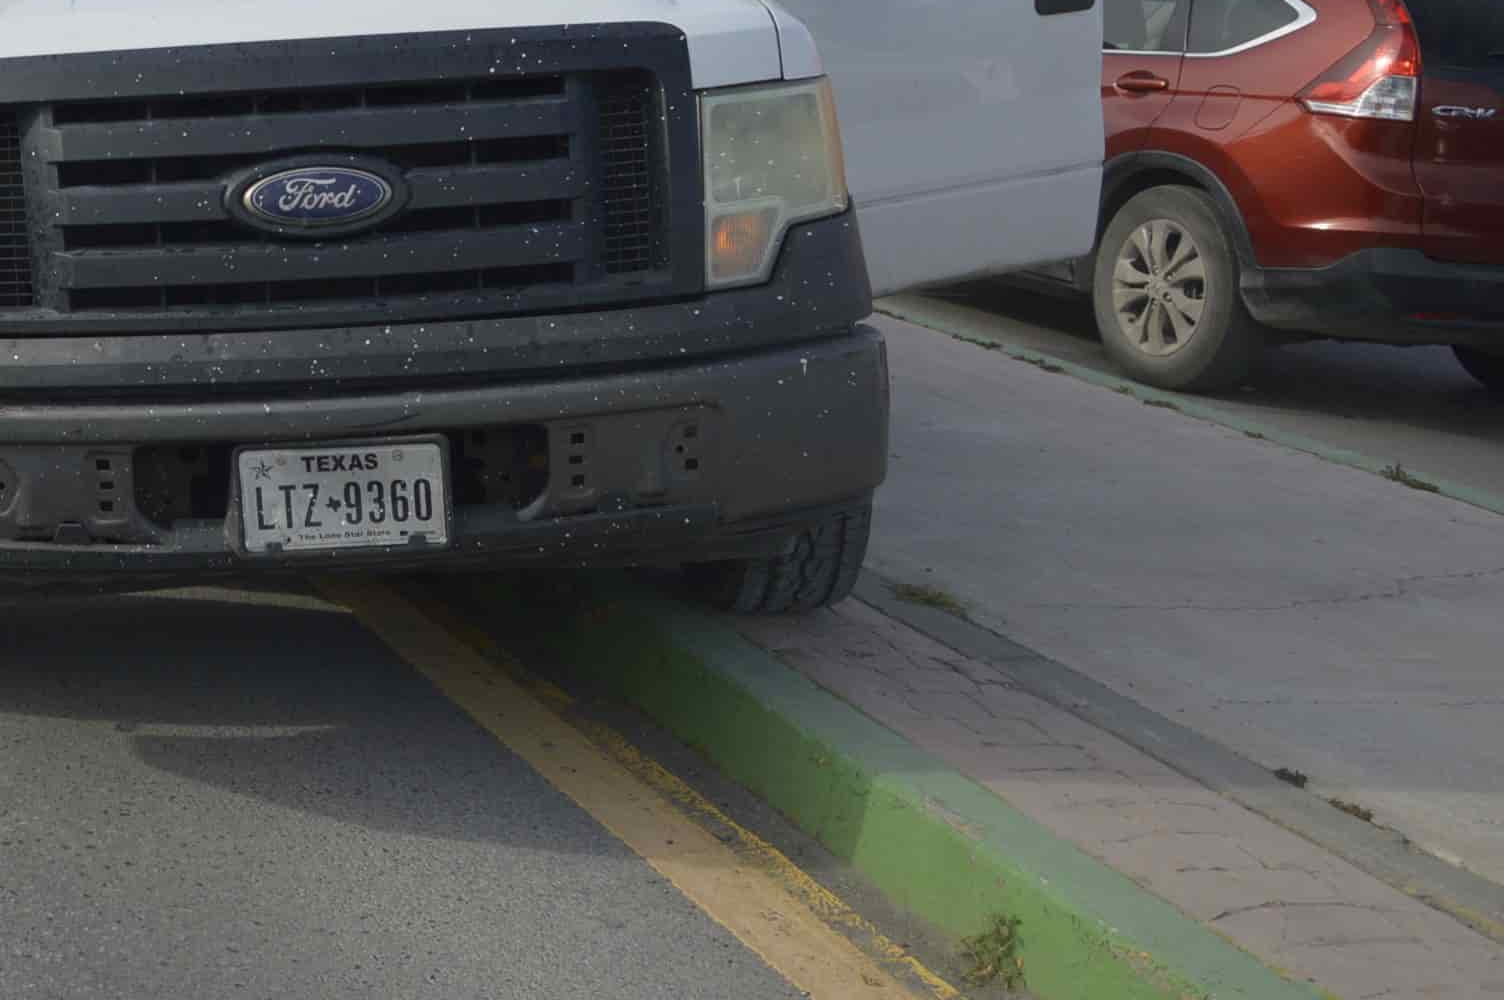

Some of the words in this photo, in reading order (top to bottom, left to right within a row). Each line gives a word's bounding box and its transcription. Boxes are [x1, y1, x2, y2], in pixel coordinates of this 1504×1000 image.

[279, 177, 357, 211] Ford
[300, 453, 378, 473] TEXAS
[344, 478, 433, 525] 9360
